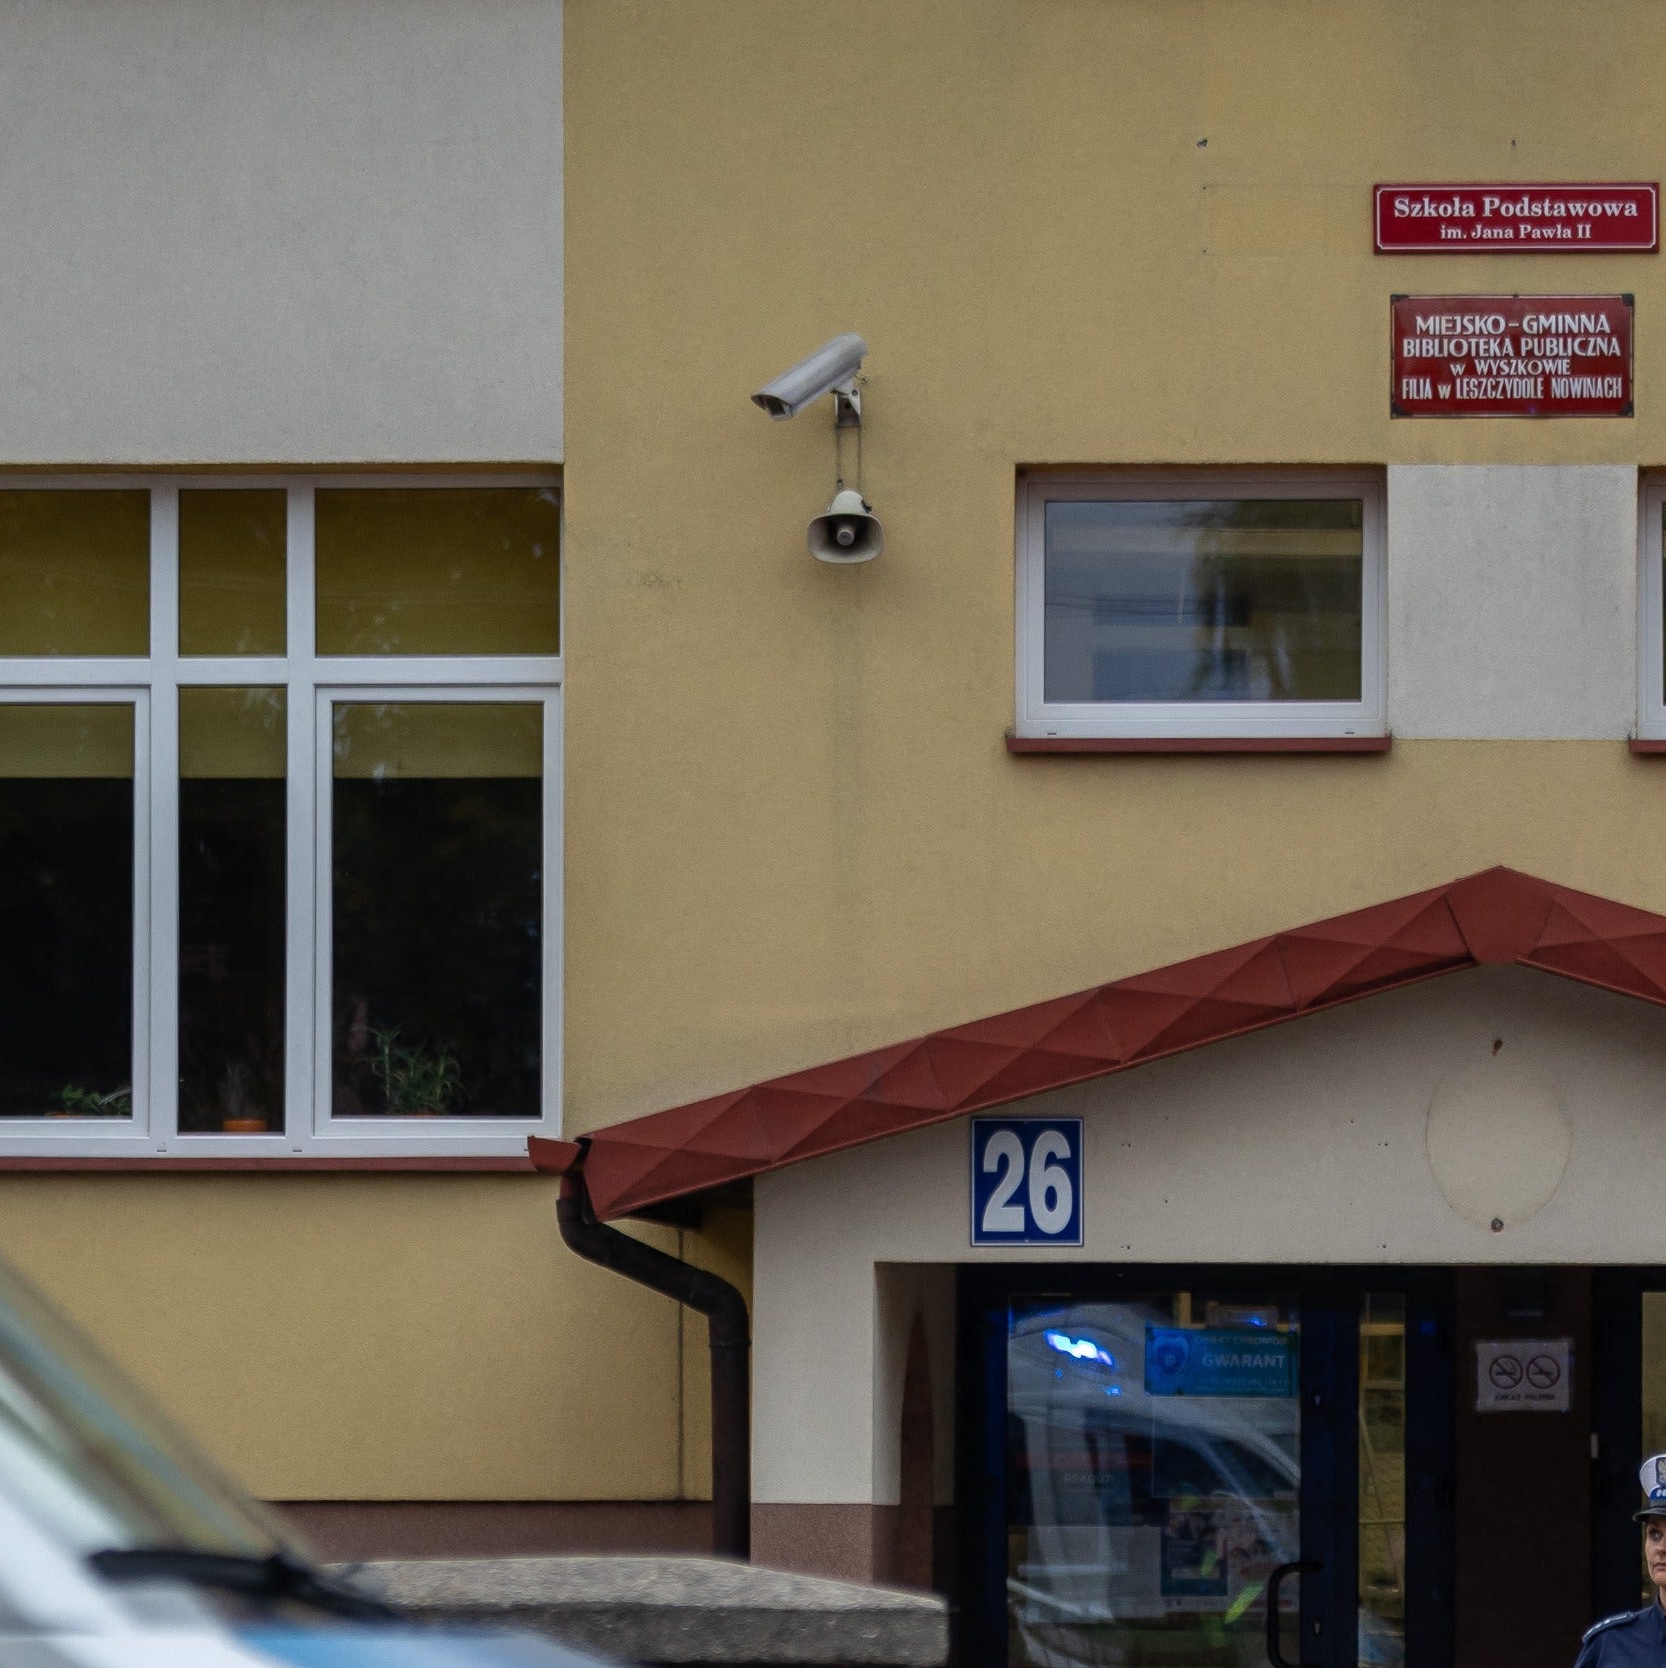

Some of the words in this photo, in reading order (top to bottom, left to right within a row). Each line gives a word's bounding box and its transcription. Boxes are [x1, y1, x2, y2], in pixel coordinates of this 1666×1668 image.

[1393, 197, 1475, 217] Szkoła
[1483, 197, 1638, 217] Podstawowa
[1440, 225, 1467, 239] im.
[1471, 225, 1514, 239] Jana
[1518, 225, 1572, 239] Pawła
[1577, 225, 1592, 239] II
[1402, 338, 1514, 358] BIBLIOTEKA
[1520, 336, 1621, 358] PUBLICZNA
[1450, 362, 1466, 376] w
[1474, 359, 1571, 376] WYSZKOWIE
[1402, 378, 1432, 400] FILIA
[1437, 384, 1452, 399] w
[1456, 378, 1544, 400] LESZCZYDOLE
[1551, 377, 1622, 399] NOWINACH
[982, 1130, 1073, 1235] 26
[1202, 1354, 1285, 1369] GWARANT
